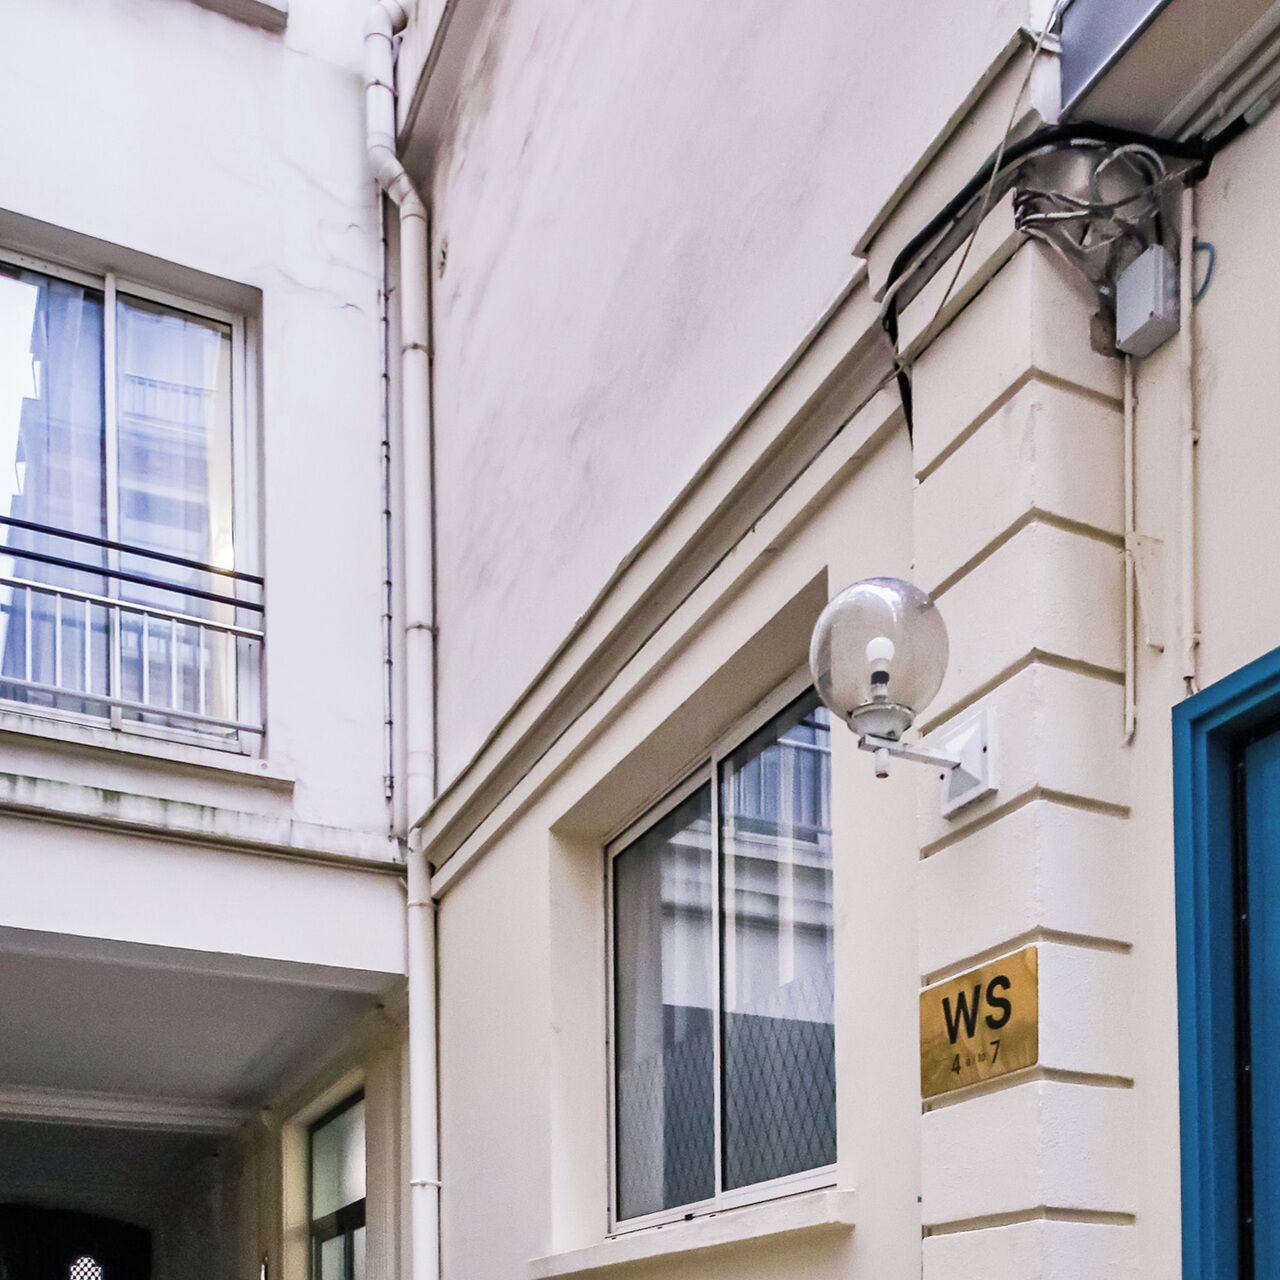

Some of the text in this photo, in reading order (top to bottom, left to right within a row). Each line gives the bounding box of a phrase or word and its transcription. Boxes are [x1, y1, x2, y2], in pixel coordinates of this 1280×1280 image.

[941, 974, 1012, 1045] WS
[951, 1053, 962, 1075] 4
[989, 1040, 1001, 1064] 7
